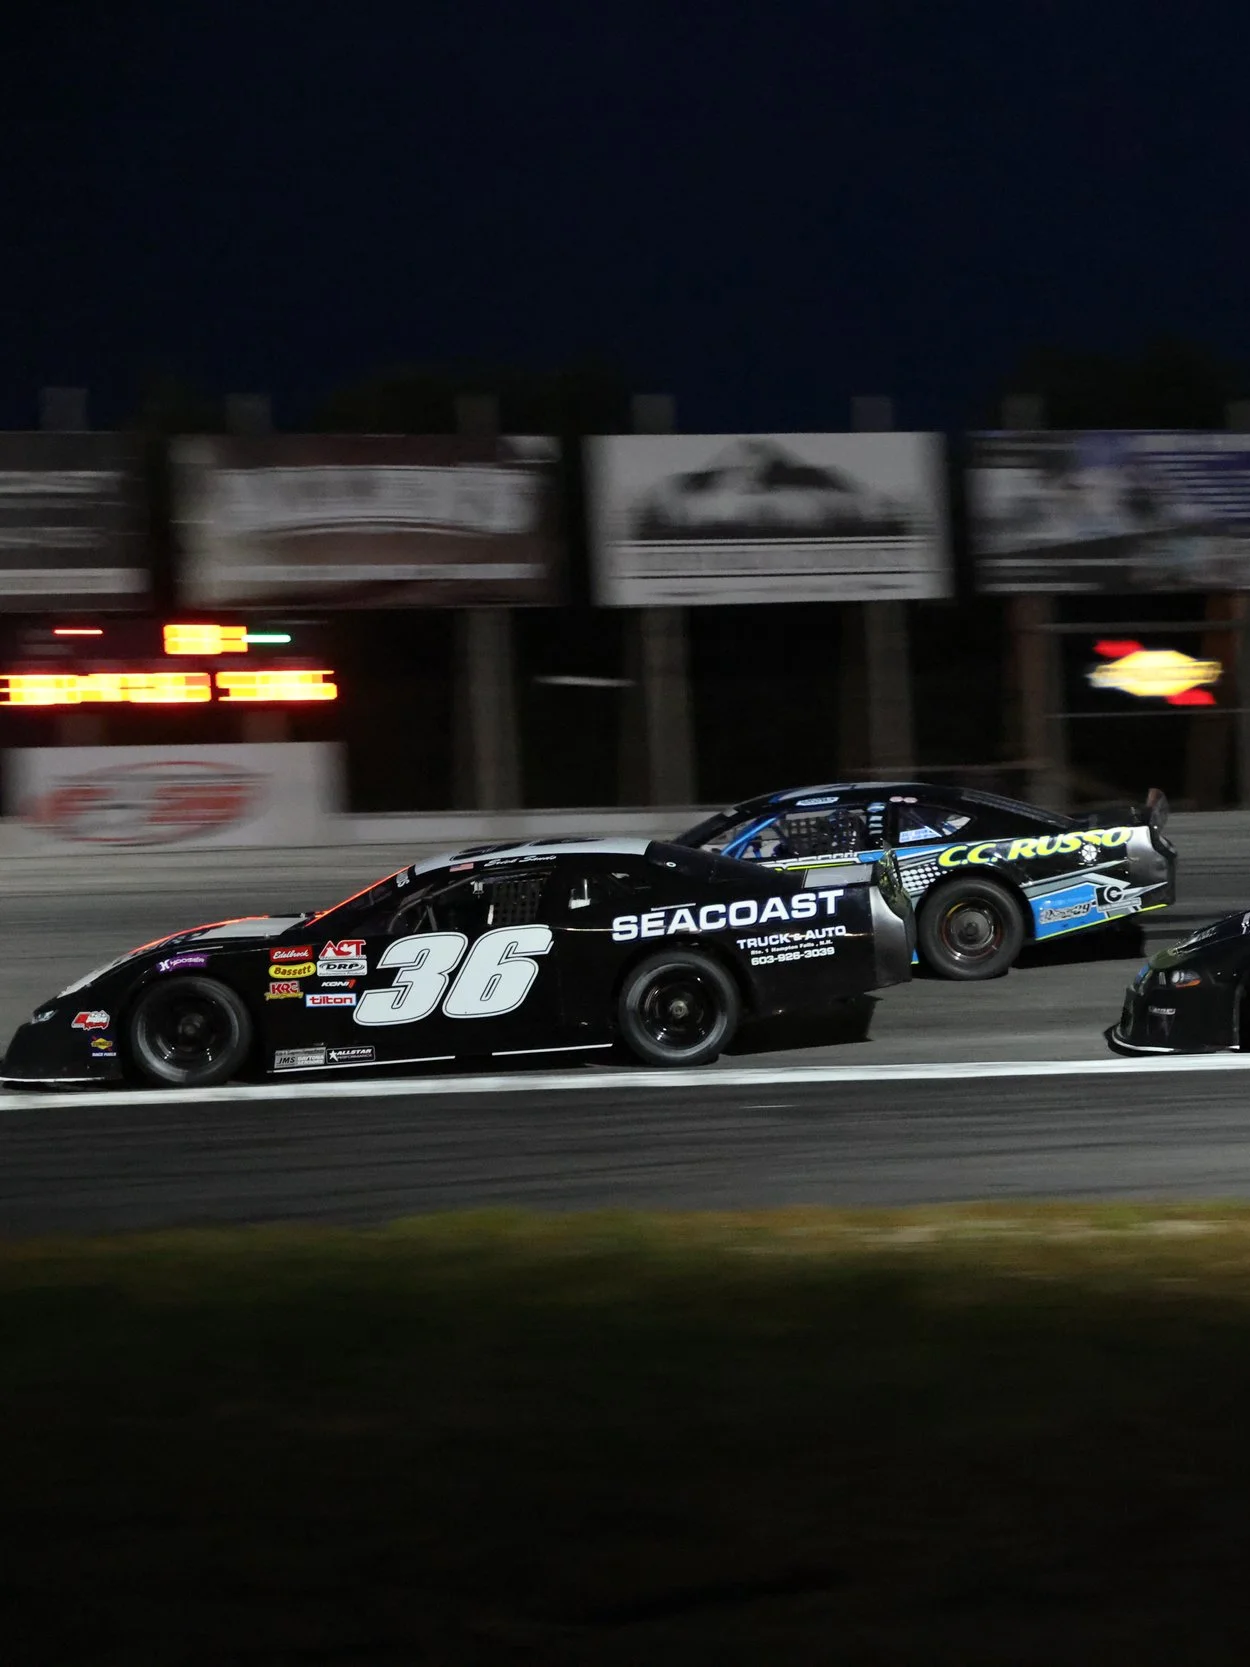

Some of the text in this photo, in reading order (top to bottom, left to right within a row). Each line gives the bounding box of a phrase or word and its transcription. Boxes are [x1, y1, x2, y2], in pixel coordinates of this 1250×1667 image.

[938, 827, 1132, 867] C.C. RUSSO
[612, 889, 844, 942] SEACOAST
[736, 925, 847, 949] TRUCK & AUTO
[272, 949, 309, 960] Edelbrock
[319, 939, 367, 959] ACT
[751, 947, 835, 966] 603-926-3039
[274, 965, 312, 975] Bassett
[353, 924, 555, 1026] 36
[321, 980, 350, 988] KONI
[310, 996, 352, 1004] tilton
